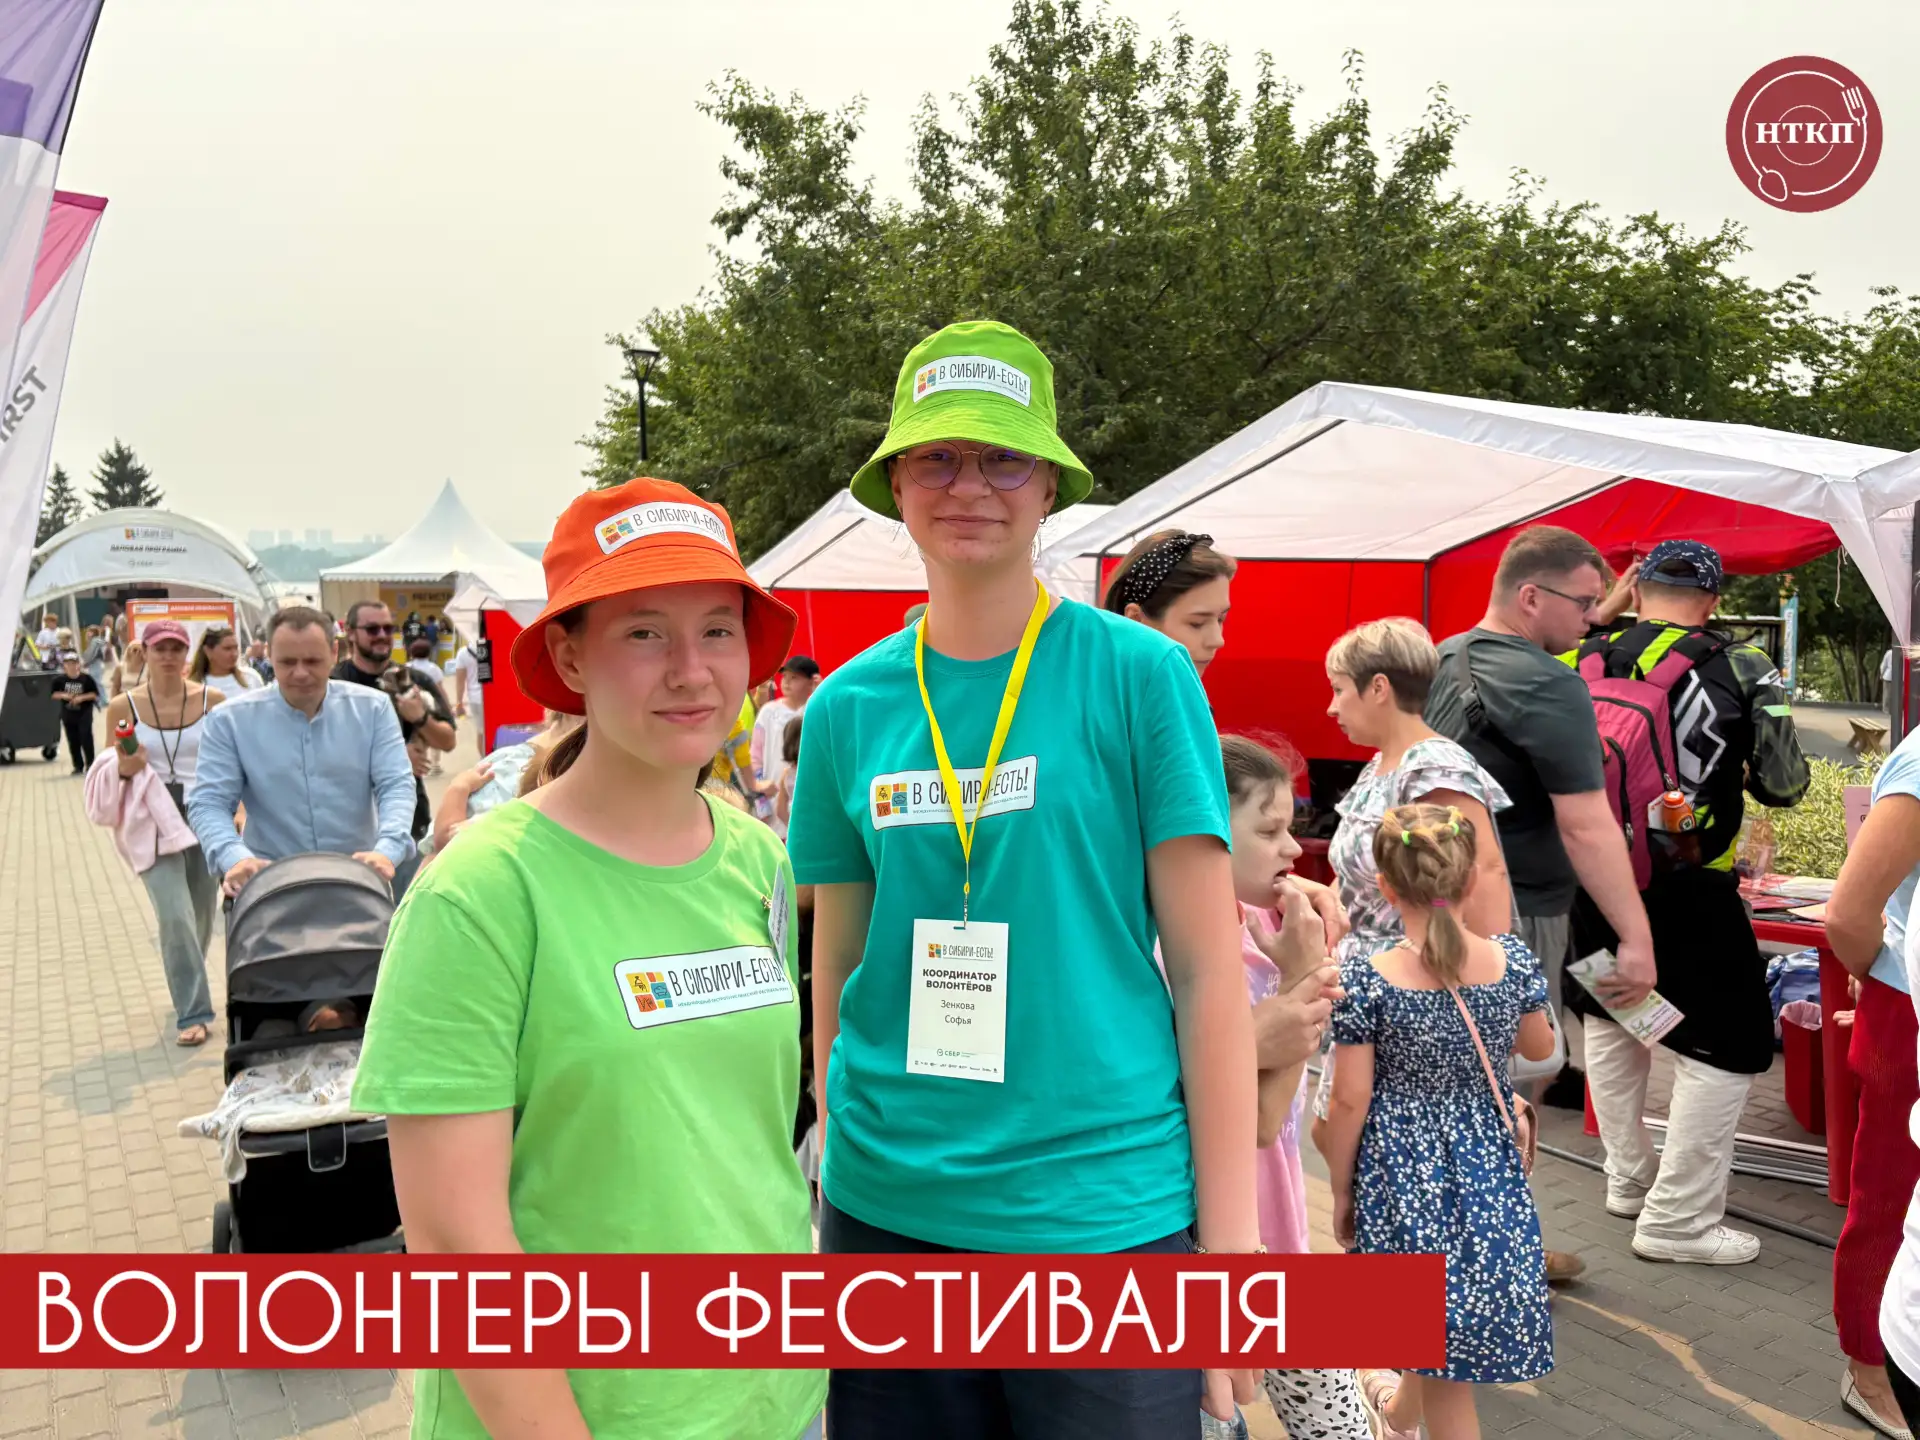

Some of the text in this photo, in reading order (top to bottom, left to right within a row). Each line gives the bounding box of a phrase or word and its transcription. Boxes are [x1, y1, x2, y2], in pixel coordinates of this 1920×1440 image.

[939, 365, 946, 380] В
[949, 362, 1028, 396] СИБИРИ-ЕСТЬ!
[633, 513, 643, 527] В
[913, 782, 922, 805] В
[942, 944, 993, 958] В СИБИРИ-ЕСТЬ!
[922, 968, 997, 981] КООРДИНАТОР
[668, 970, 682, 997] В
[926, 980, 992, 993] ВОЛОНТЁРОВ
[940, 999, 975, 1011] Зенкова
[944, 1014, 972, 1026] Софья
